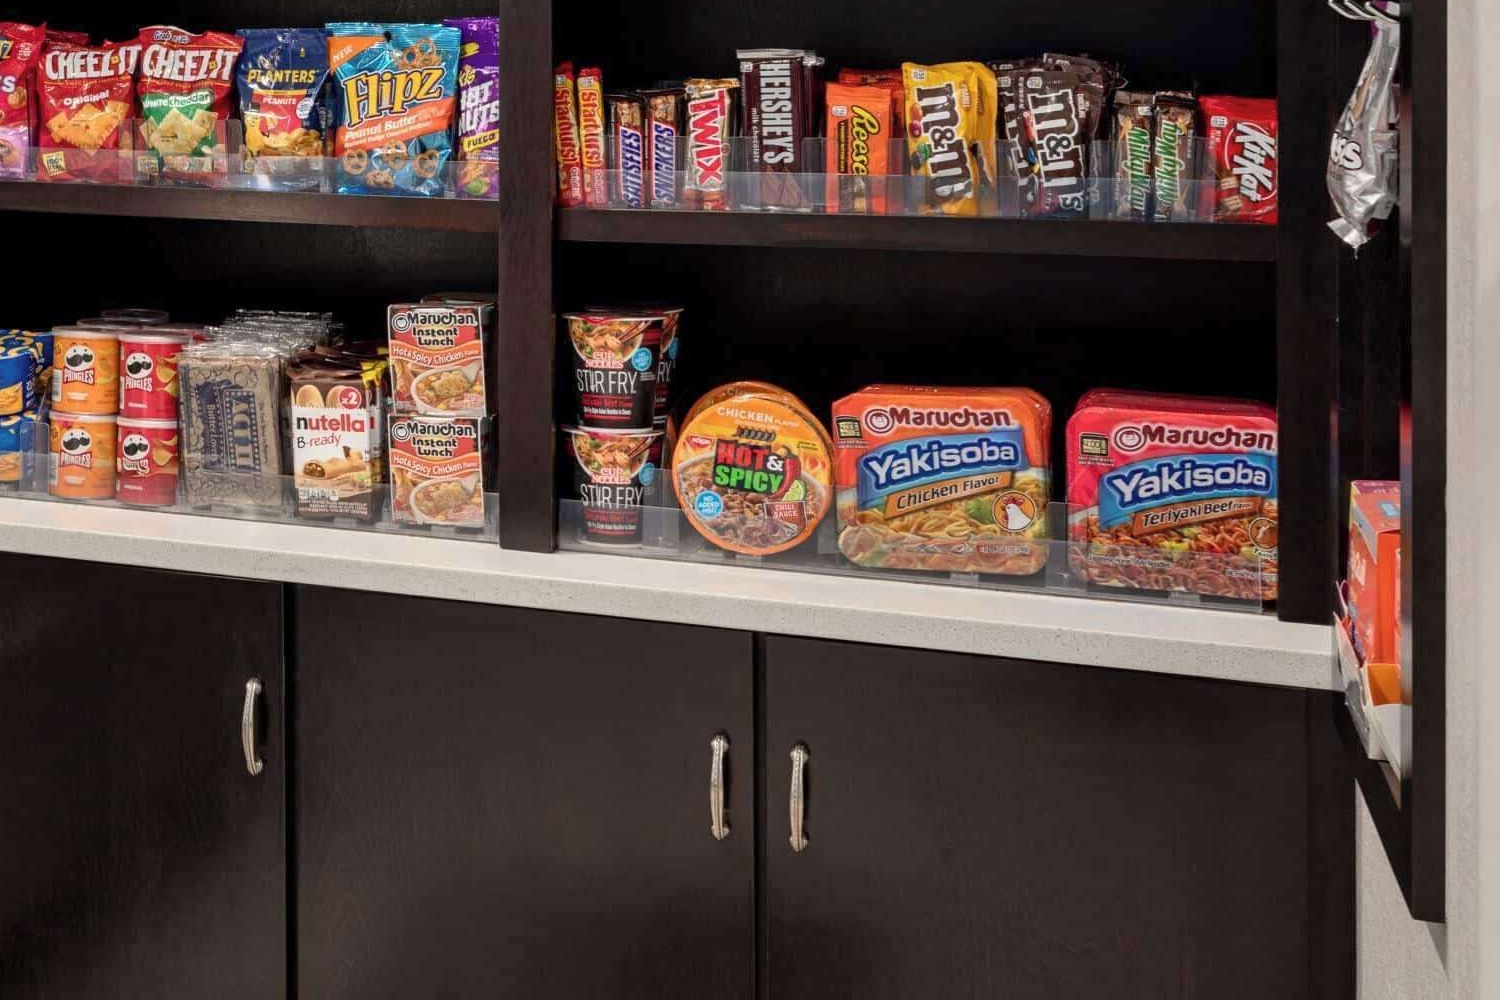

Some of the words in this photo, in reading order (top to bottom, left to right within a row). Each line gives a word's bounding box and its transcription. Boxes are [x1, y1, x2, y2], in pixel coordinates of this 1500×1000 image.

[331, 44, 353, 63] NEW
[247, 69, 317, 84] PLANTERS
[263, 97, 297, 105] PEANUTS
[342, 66, 446, 128] Flipz
[759, 60, 795, 165] HERSHEY'S
[466, 133, 497, 148] FUEGO
[688, 88, 726, 186] TWIX
[653, 123, 675, 200] SNICKERS
[407, 312, 476, 327] Maruchan
[412, 326, 459, 337] Instant
[418, 336, 454, 346] Lunch
[63, 369, 94, 385] PRINGLES
[125, 377, 152, 392] PRINGLES
[576, 368, 606, 394] STIR
[608, 371, 638, 395] FRY
[296, 414, 365, 433] nutella
[889, 407, 1011, 426] Maruchan
[407, 422, 476, 437] Maruchan
[1141, 425, 1275, 450] Maruchan
[412, 436, 457, 447] Instant
[60, 451, 92, 468] PRINGLES
[418, 446, 453, 457] Lunch
[717, 440, 767, 465] HOT
[766, 454, 783, 471] &
[867, 440, 1016, 485] Yakisoba
[715, 465, 783, 494] SPICY
[1112, 463, 1268, 502] Yakisoba
[615, 487, 643, 507] FRY
[897, 483, 959, 511] Chicken
[963, 476, 1001, 492] Flavor
[1143, 504, 1202, 527] Teriyaki
[1204, 501, 1233, 515] Beef
